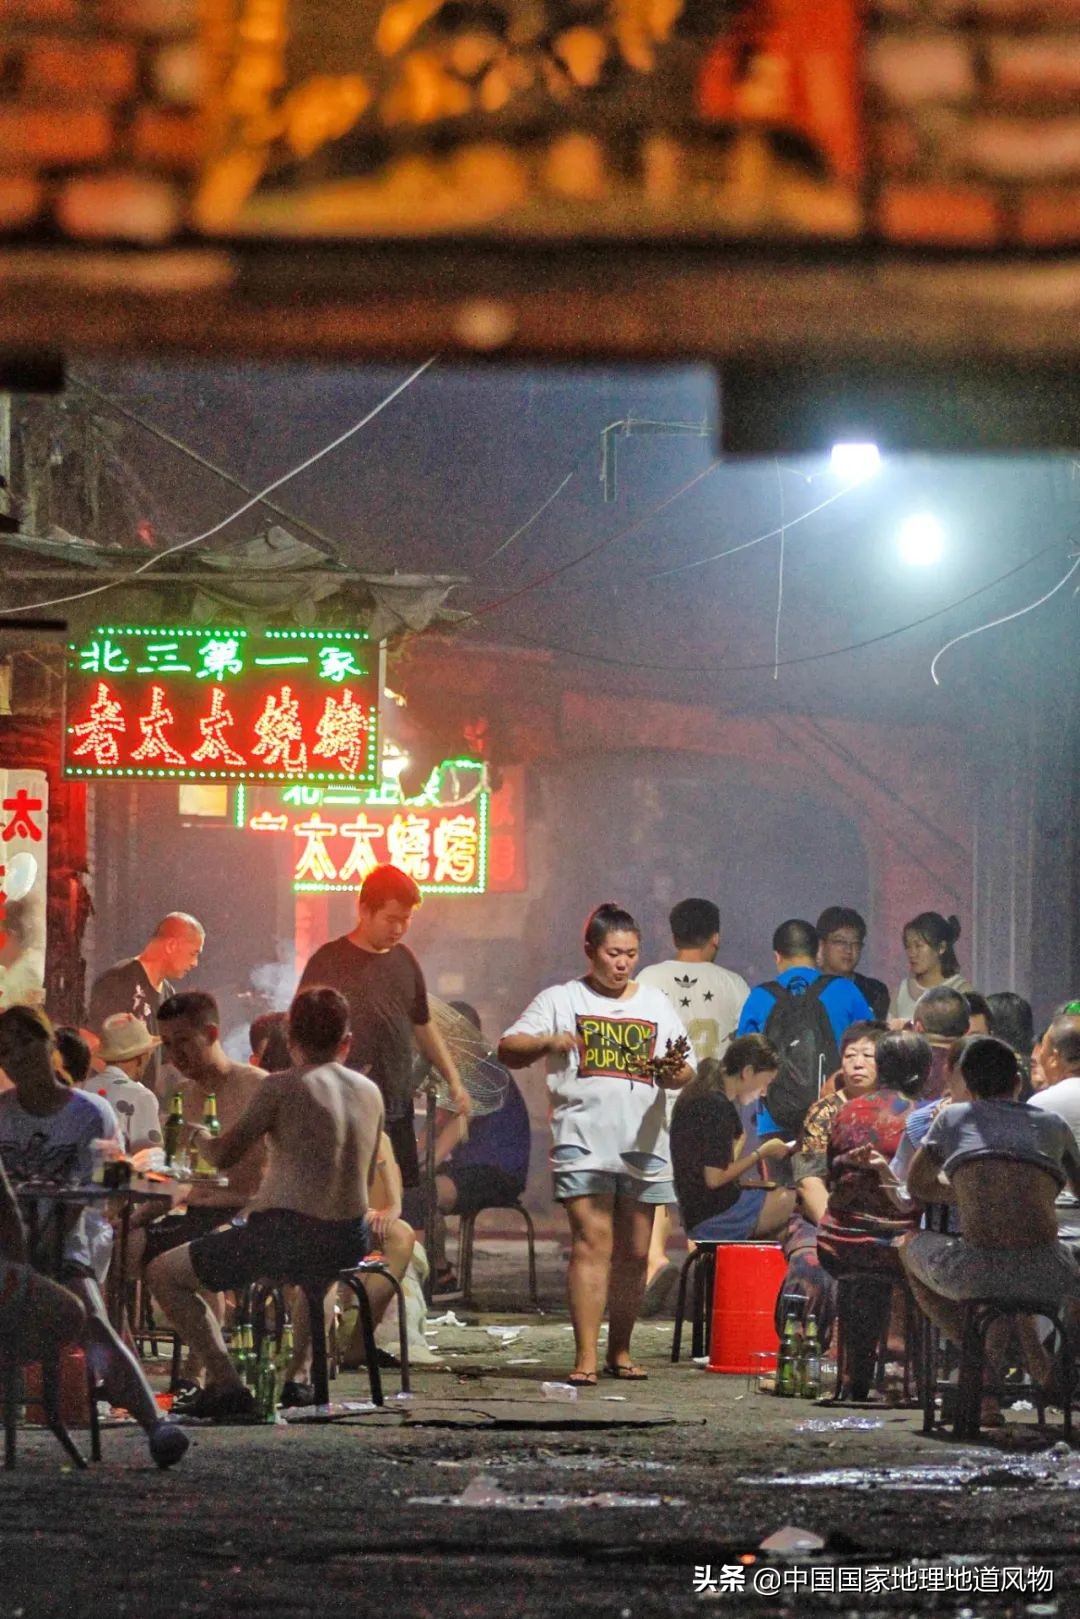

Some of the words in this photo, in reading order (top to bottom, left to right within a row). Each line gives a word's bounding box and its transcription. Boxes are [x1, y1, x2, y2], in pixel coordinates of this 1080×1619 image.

[80, 638, 369, 682] 北三第一家
[2, 789, 43, 842] 太
